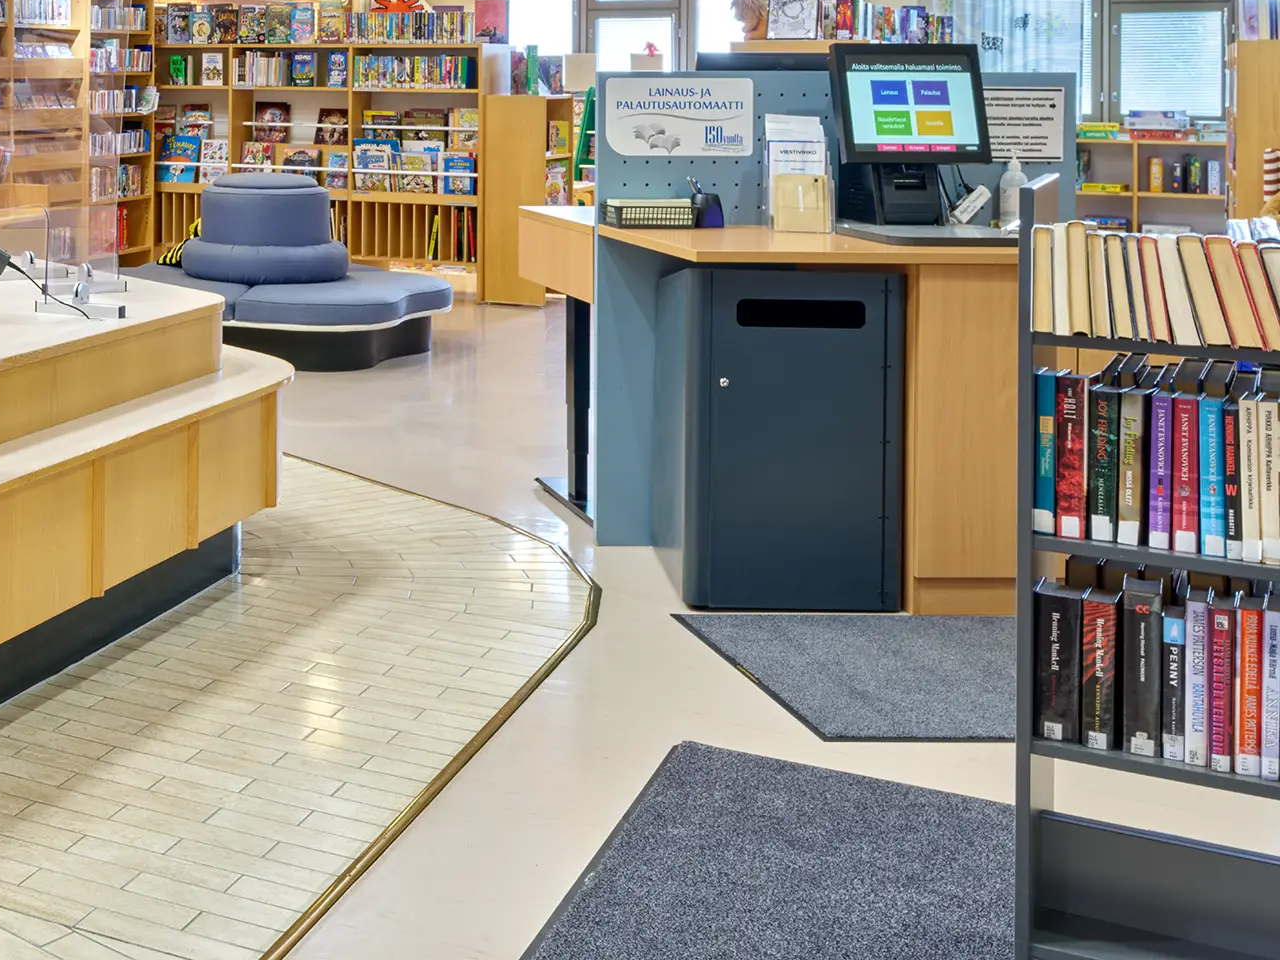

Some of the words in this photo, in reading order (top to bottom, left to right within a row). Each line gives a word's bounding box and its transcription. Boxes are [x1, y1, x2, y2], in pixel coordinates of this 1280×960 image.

[851, 63, 870, 71] Aloita
[870, 63, 905, 71] valitsemalla
[905, 63, 935, 71] haluamasi
[616, 101, 743, 110] PALAUTUSAUTOMAATTI
[649, 87, 698, 97] LAINAUS-
[700, 88, 711, 99] JA
[705, 125, 723, 144] 150
[723, 134, 743, 144] vuotta
[1064, 398, 1076, 419] HOLT
[1097, 399, 1108, 417] JOY
[1157, 409, 1166, 431] JANET
[1123, 416, 1138, 430] Joy
[1180, 413, 1189, 437] JANET
[1207, 413, 1216, 437] JANET
[1225, 415, 1234, 445] HENNING
[1097, 419, 1107, 460] FIELDING
[1124, 431, 1139, 465] Fielding
[1157, 432, 1165, 475] EVANOVICH
[1181, 438, 1189, 481] EVANOVICH
[1208, 438, 1216, 481] EVANOVICH
[1225, 445, 1235, 476] MANKELL
[1050, 612, 1060, 642] Henning
[1094, 618, 1105, 648] Henning
[1192, 610, 1205, 634] JAMES
[1247, 615, 1258, 633] PAHA
[1051, 643, 1060, 671] Mankell
[1192, 634, 1205, 676] PATTERSON
[1246, 634, 1258, 662] KULKEE
[1095, 649, 1104, 677] Mankell
[1169, 646, 1179, 687] PENNY
[1213, 638, 1225, 700] PETSAMON
[1245, 663, 1259, 690] EDELLÄ
[1192, 683, 1204, 733] RANTAHUVILA
[1245, 694, 1257, 717] JAMES
[1265, 686, 1278, 749] ANNIKA
